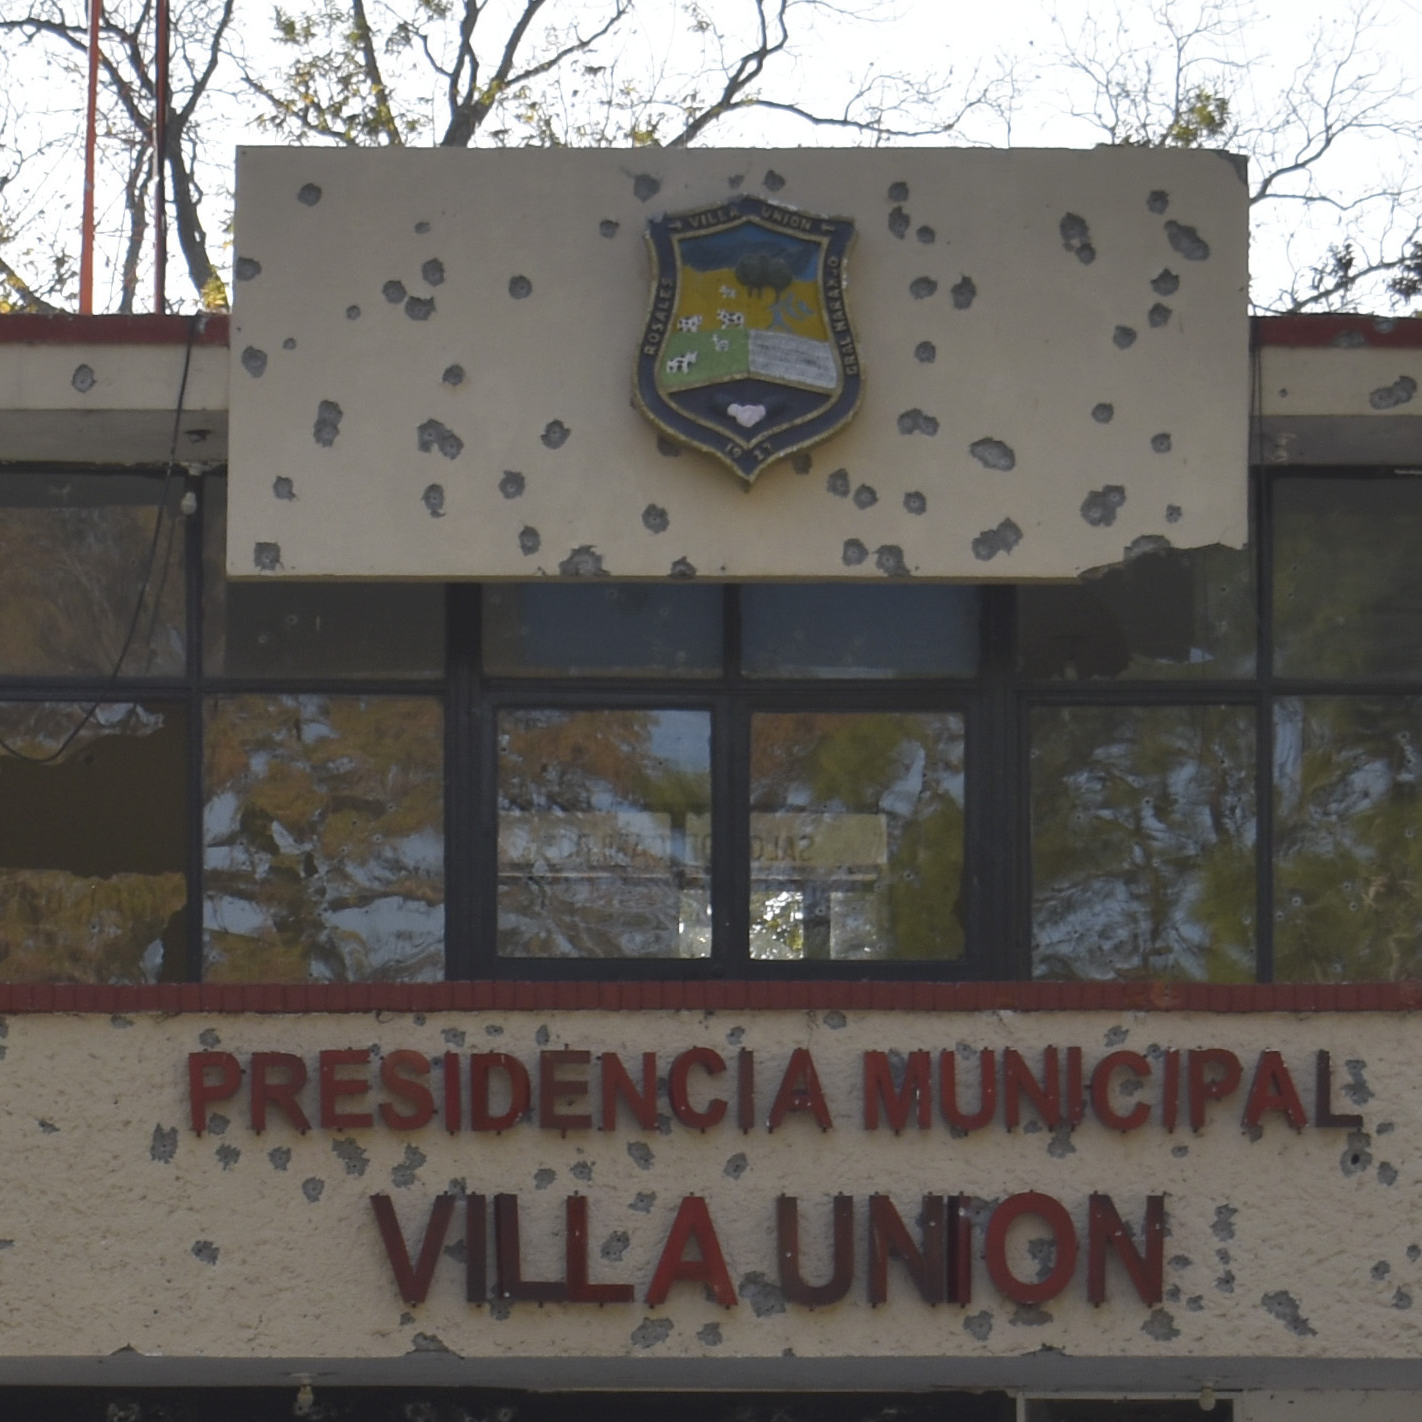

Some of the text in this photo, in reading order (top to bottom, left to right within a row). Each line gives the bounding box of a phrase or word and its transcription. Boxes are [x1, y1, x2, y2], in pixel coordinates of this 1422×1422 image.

[643, 277, 674, 356] ROSALES
[188, 1046, 1363, 1133] PRESIDENCIA MUNICIPAL
[369, 1190, 1165, 1307] VILLA UNION
